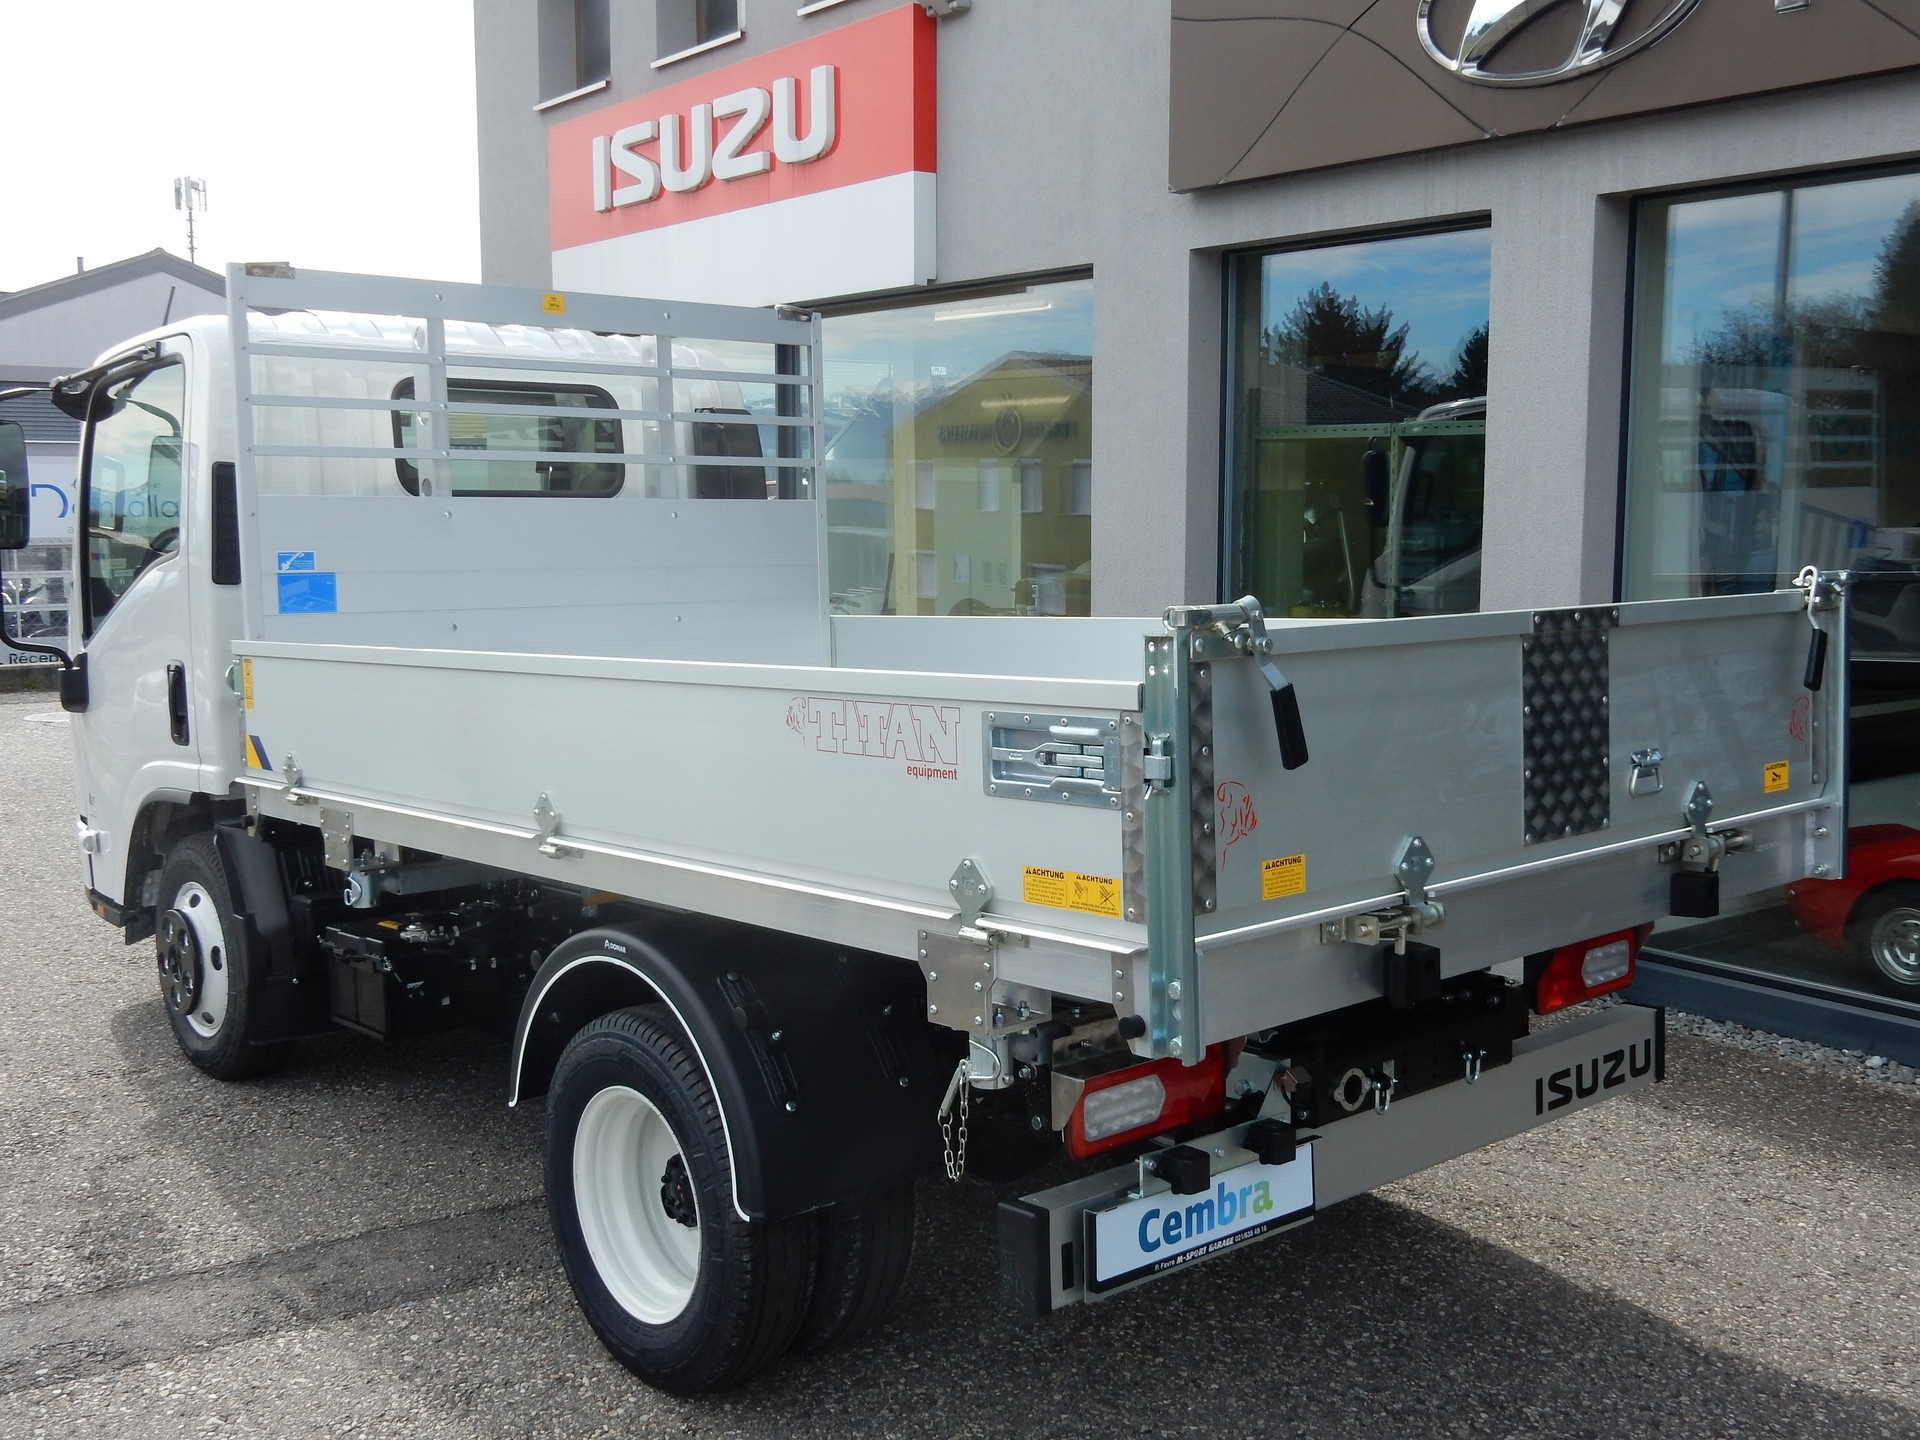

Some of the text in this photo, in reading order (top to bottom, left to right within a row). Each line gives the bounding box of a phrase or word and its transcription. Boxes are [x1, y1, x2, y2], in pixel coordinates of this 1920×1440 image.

[593, 64, 835, 213] ISUZU
[808, 697, 960, 765] TITAN
[906, 765, 958, 780] equipment
[1032, 868, 1064, 879] ACHTUNG
[1272, 856, 1302, 868] ACHTUNG
[1082, 875, 1113, 885] ACHTUNG
[1535, 1038, 1651, 1116] ISUZU
[1138, 1180, 1274, 1253] Cembra
[1160, 1259, 1175, 1270] Favre
[1176, 1246, 1207, 1264] M-SPORT
[1208, 1236, 1234, 1252] GARAGE
